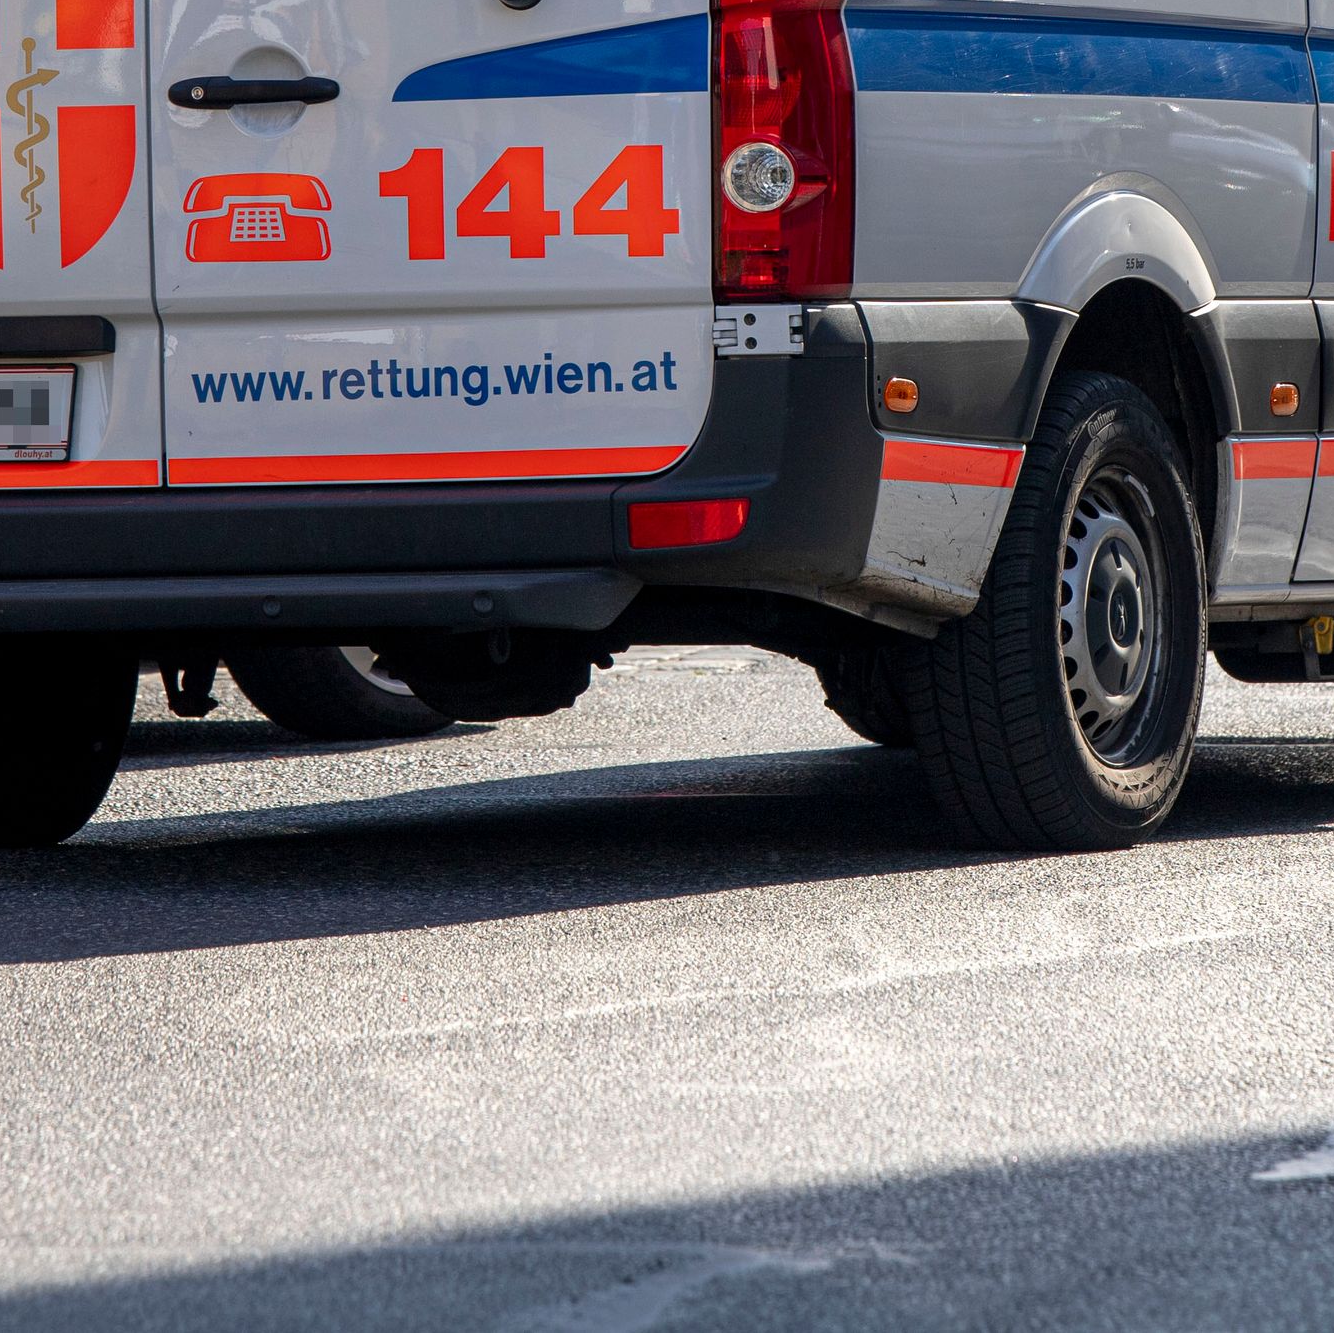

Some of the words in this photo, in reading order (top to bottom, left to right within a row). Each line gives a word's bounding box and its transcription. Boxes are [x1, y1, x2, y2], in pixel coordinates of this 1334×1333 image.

[378, 144, 681, 261] 144
[192, 351, 678, 408] www.rettung.wien.at
[14, 449, 53, 459] dlouhy.at
